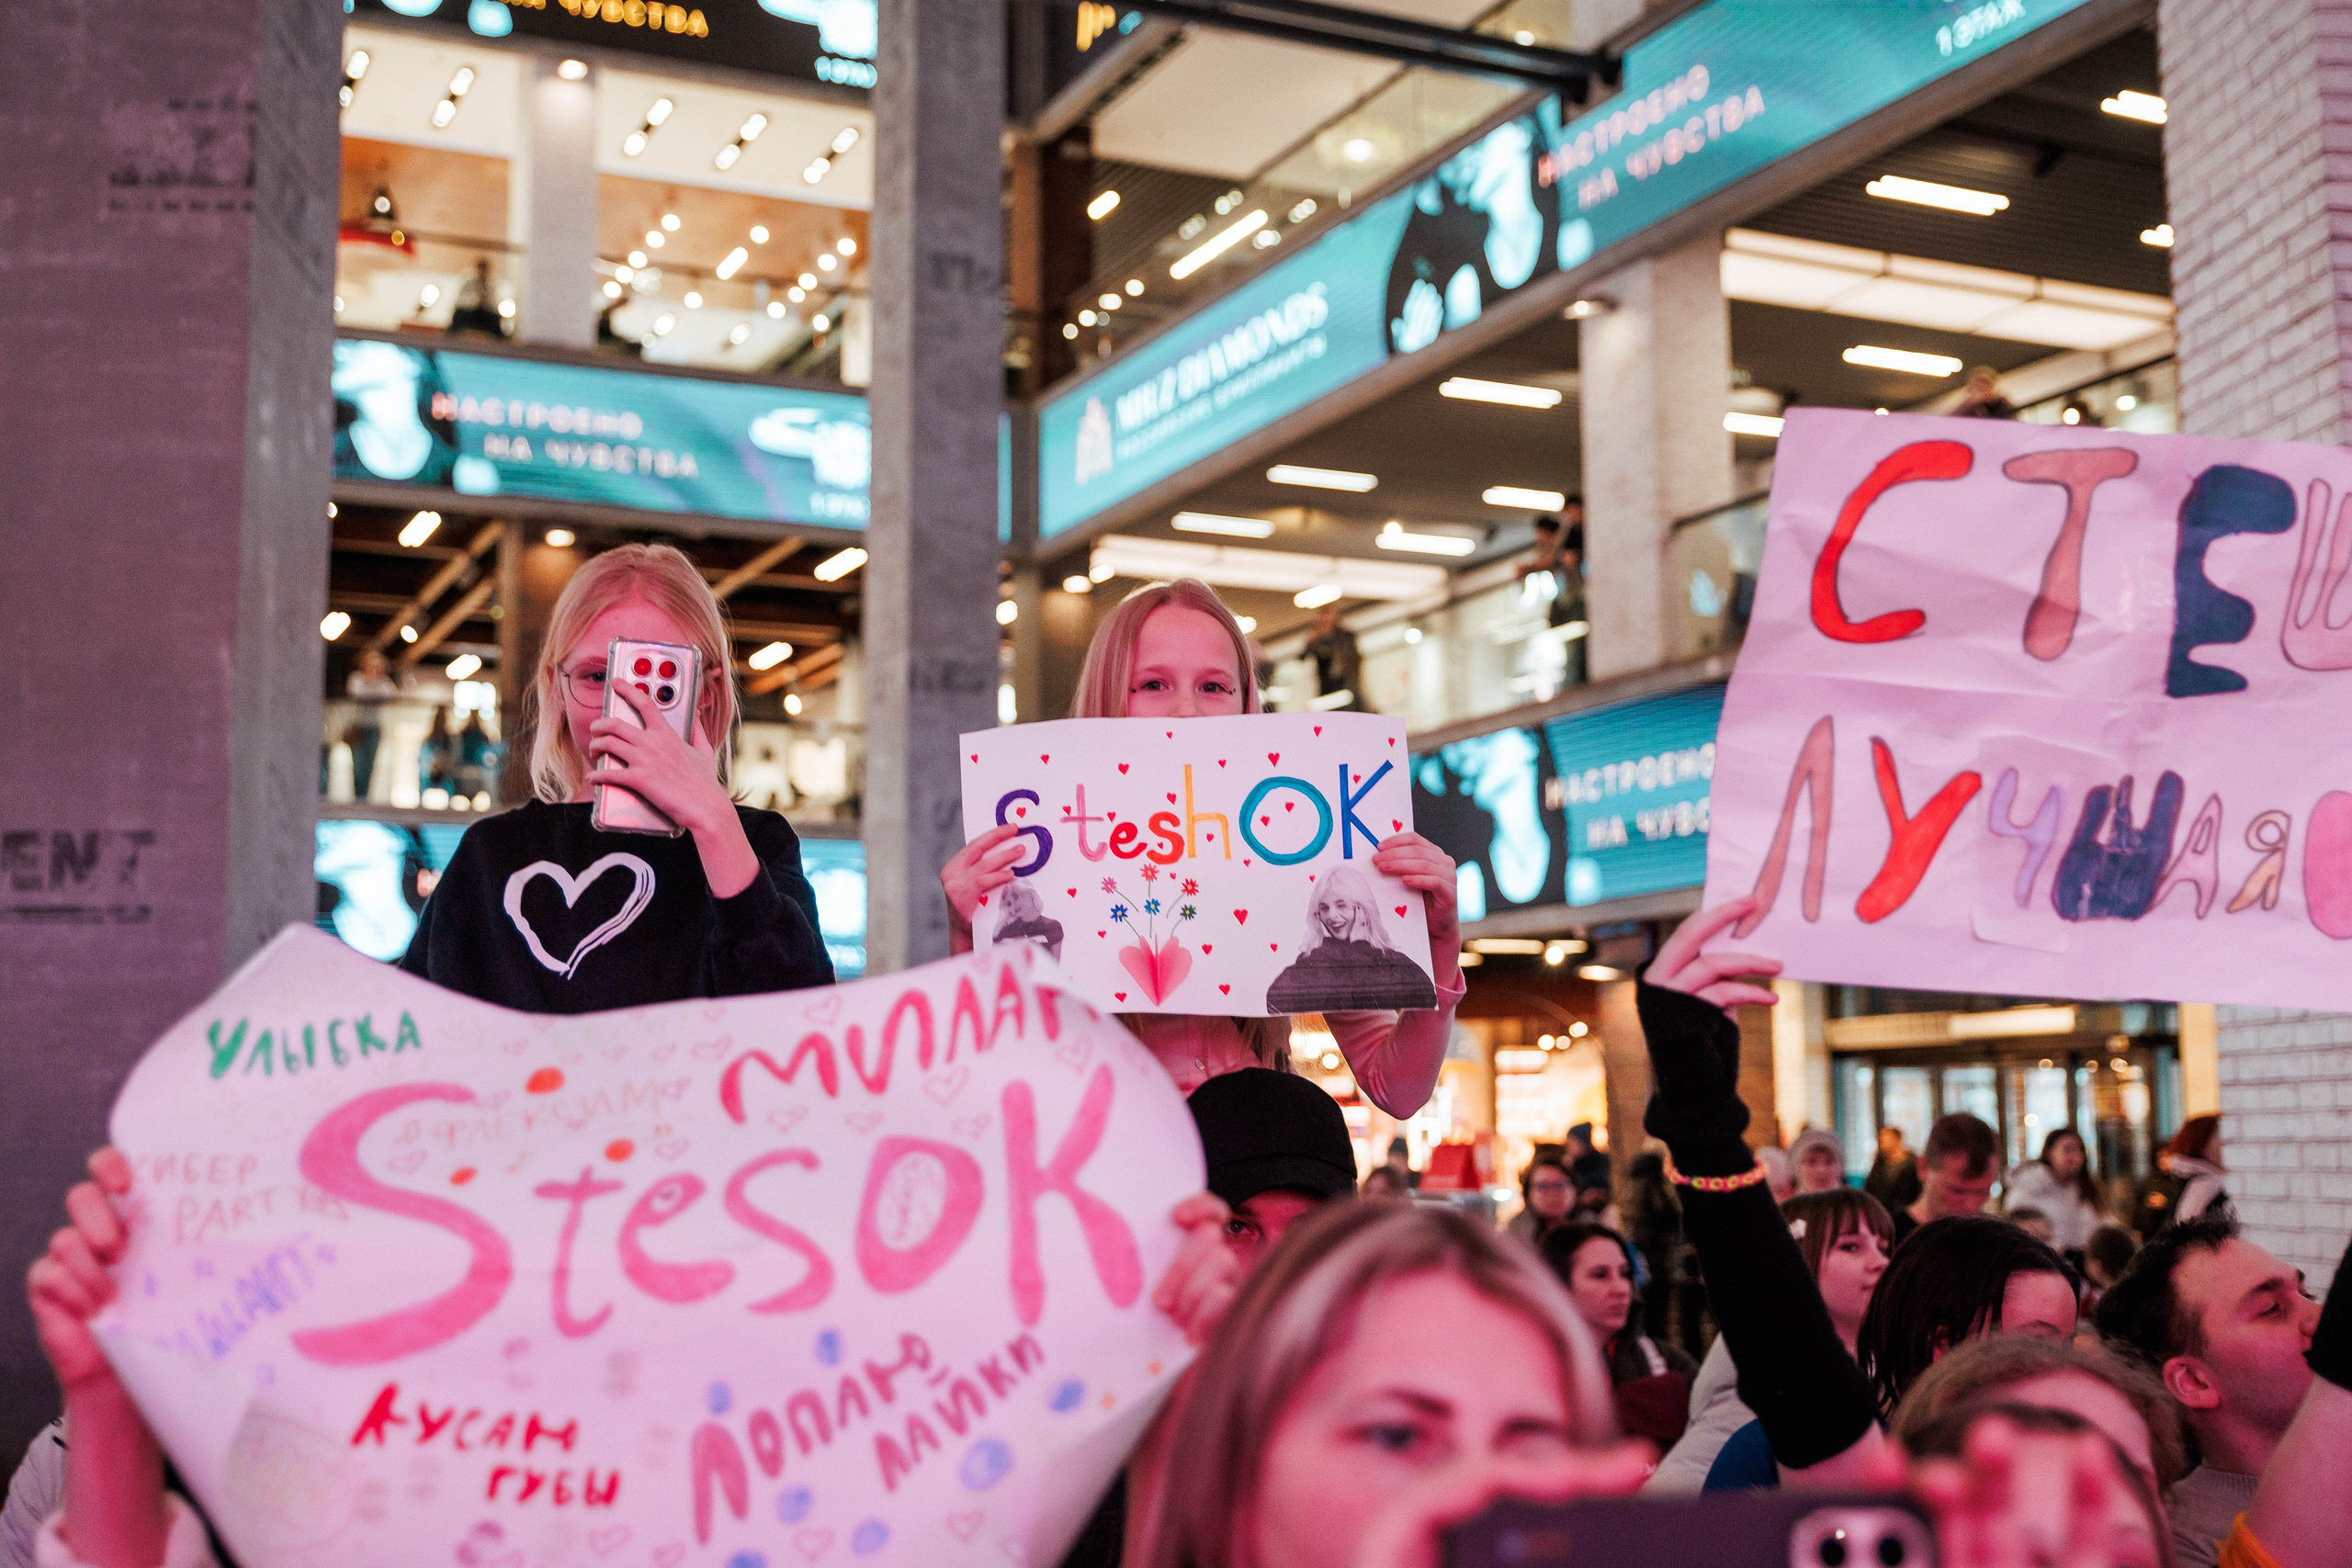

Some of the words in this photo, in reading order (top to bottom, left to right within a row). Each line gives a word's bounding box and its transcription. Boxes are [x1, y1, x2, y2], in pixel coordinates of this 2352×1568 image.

[1538, 64, 1710, 188] НАСТРОЕНО
[1577, 166, 1620, 212] НА
[1625, 85, 1766, 182] ЧУВСТВА
[431, 390, 643, 441] НАСТРОЕНО
[483, 432, 533, 465] НА
[544, 437, 700, 479] ЧУВСТВА
[995, 760, 1394, 877] SteshOK
[1587, 814, 1629, 851] НА
[1731, 714, 2293, 939] ЛУЧШАЯ
[207, 1010, 422, 1080] УЛЫБКА
[485, 1464, 621, 1507] ГУБЫ
